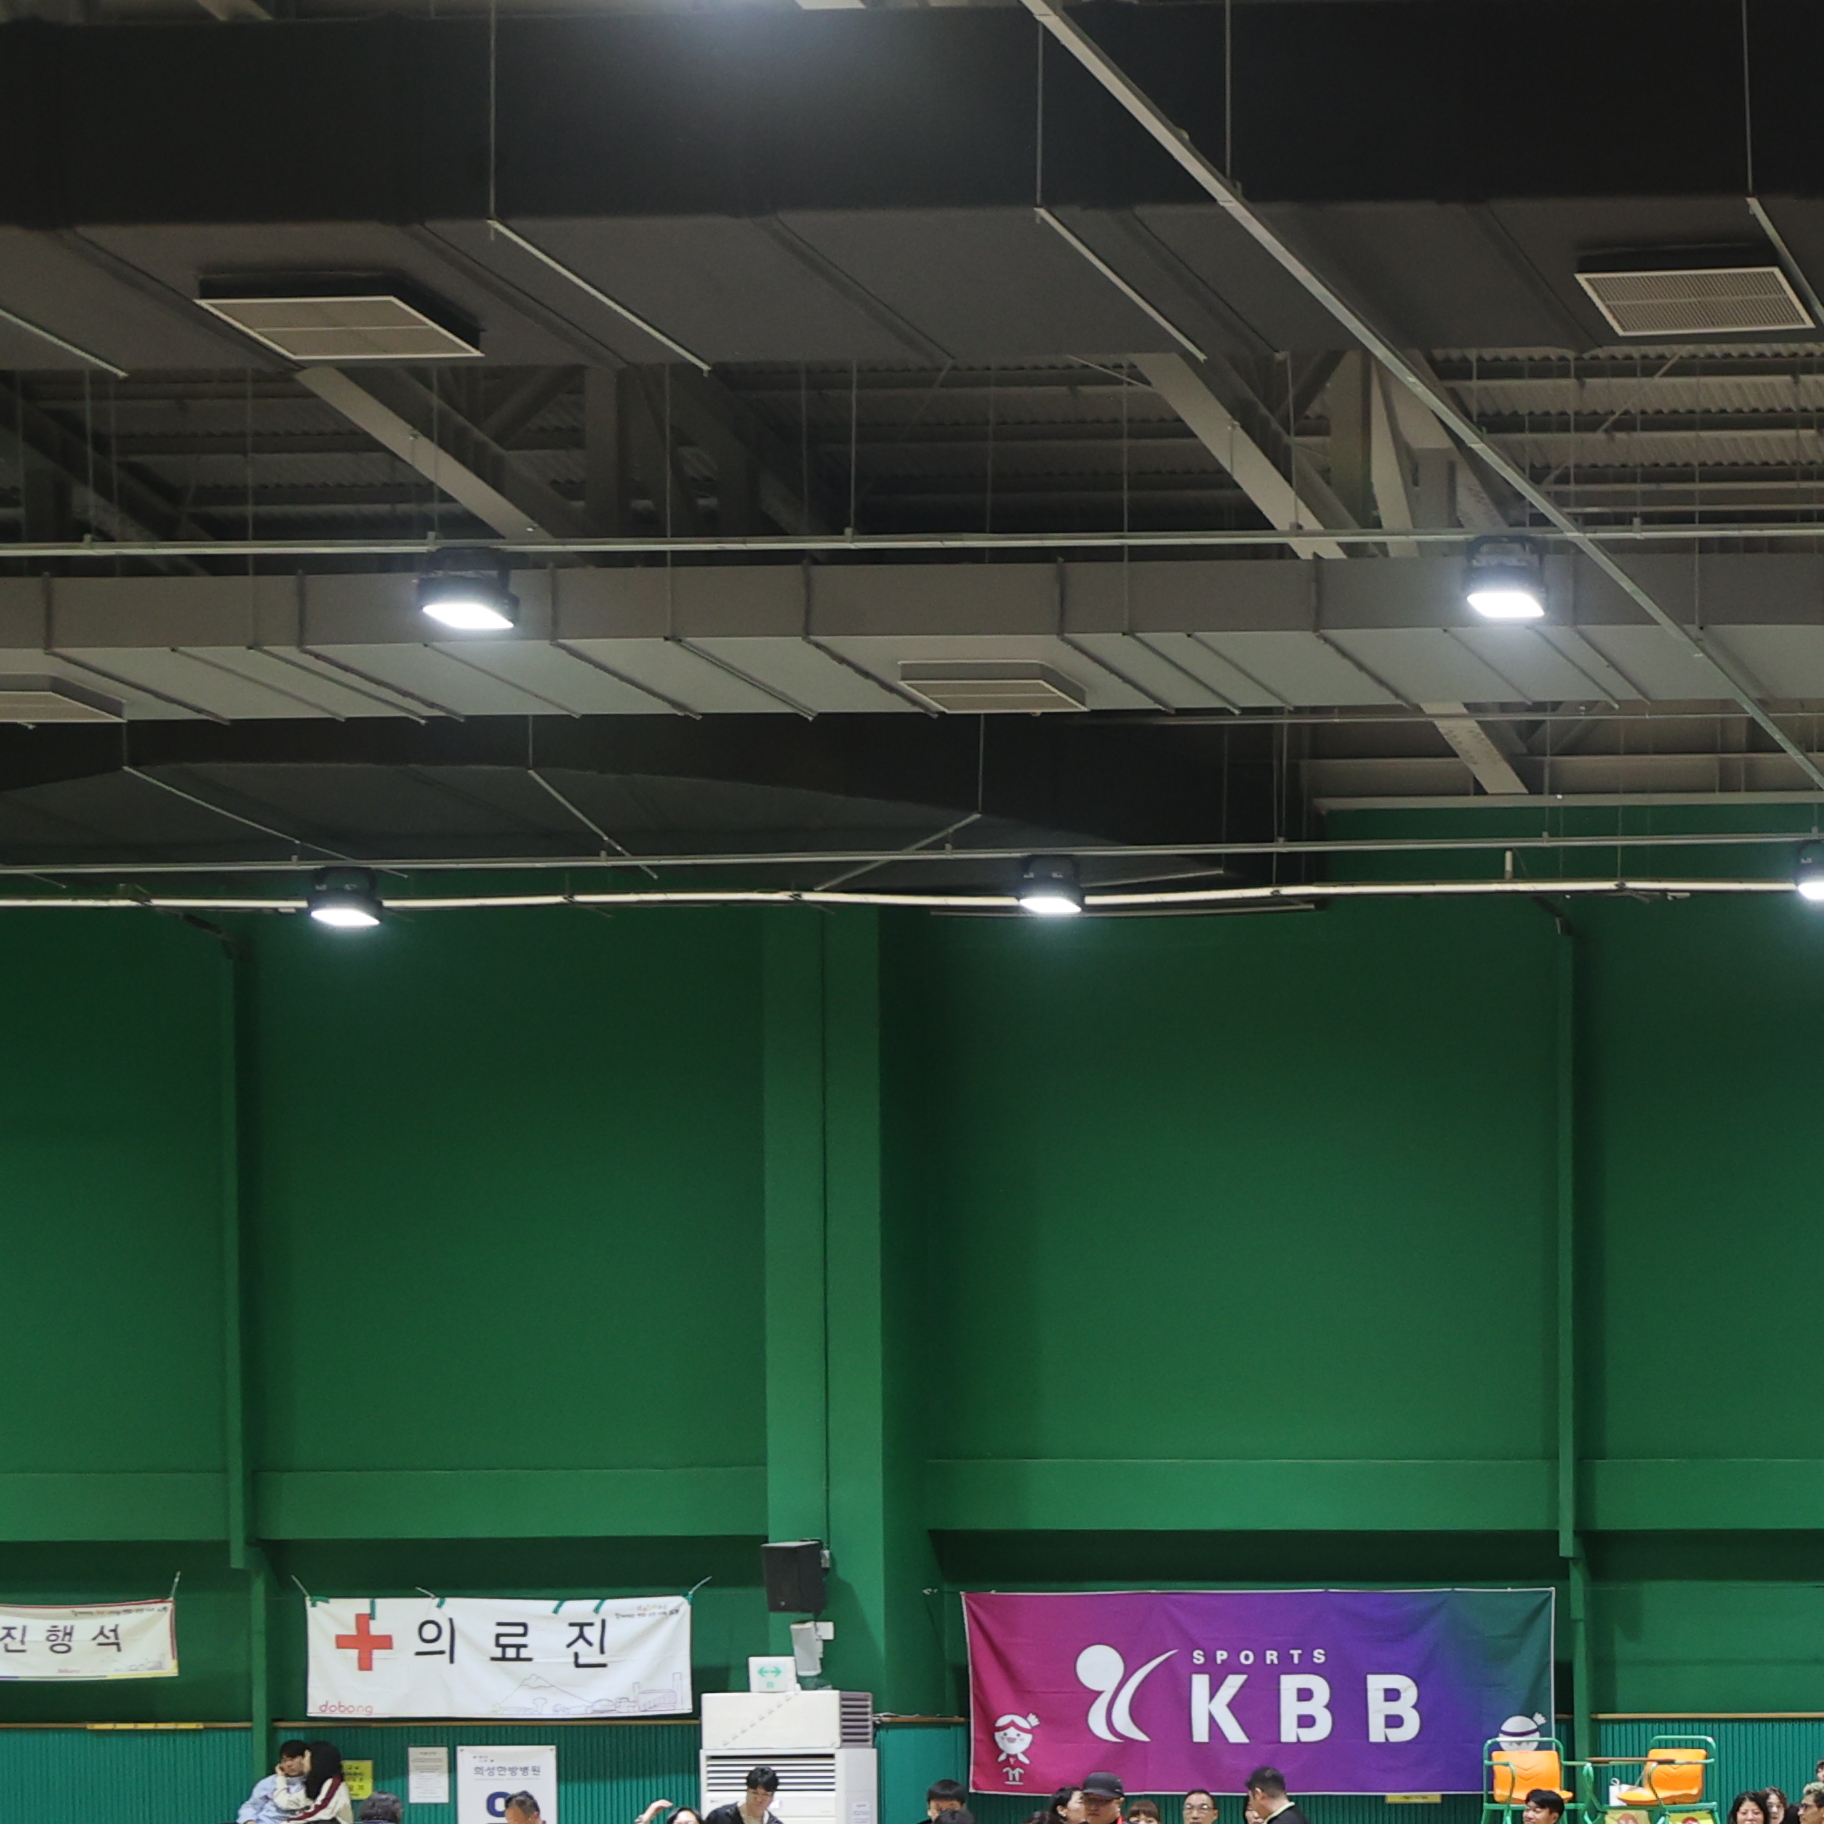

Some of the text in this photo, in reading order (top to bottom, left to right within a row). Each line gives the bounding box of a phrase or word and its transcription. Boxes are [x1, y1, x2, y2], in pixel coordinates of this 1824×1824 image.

[414, 1617, 608, 1669] 의료진
[1192, 1648, 1327, 1666] SPORTS
[319, 1700, 374, 1716] dobong
[1190, 1673, 1421, 1744] KBB
